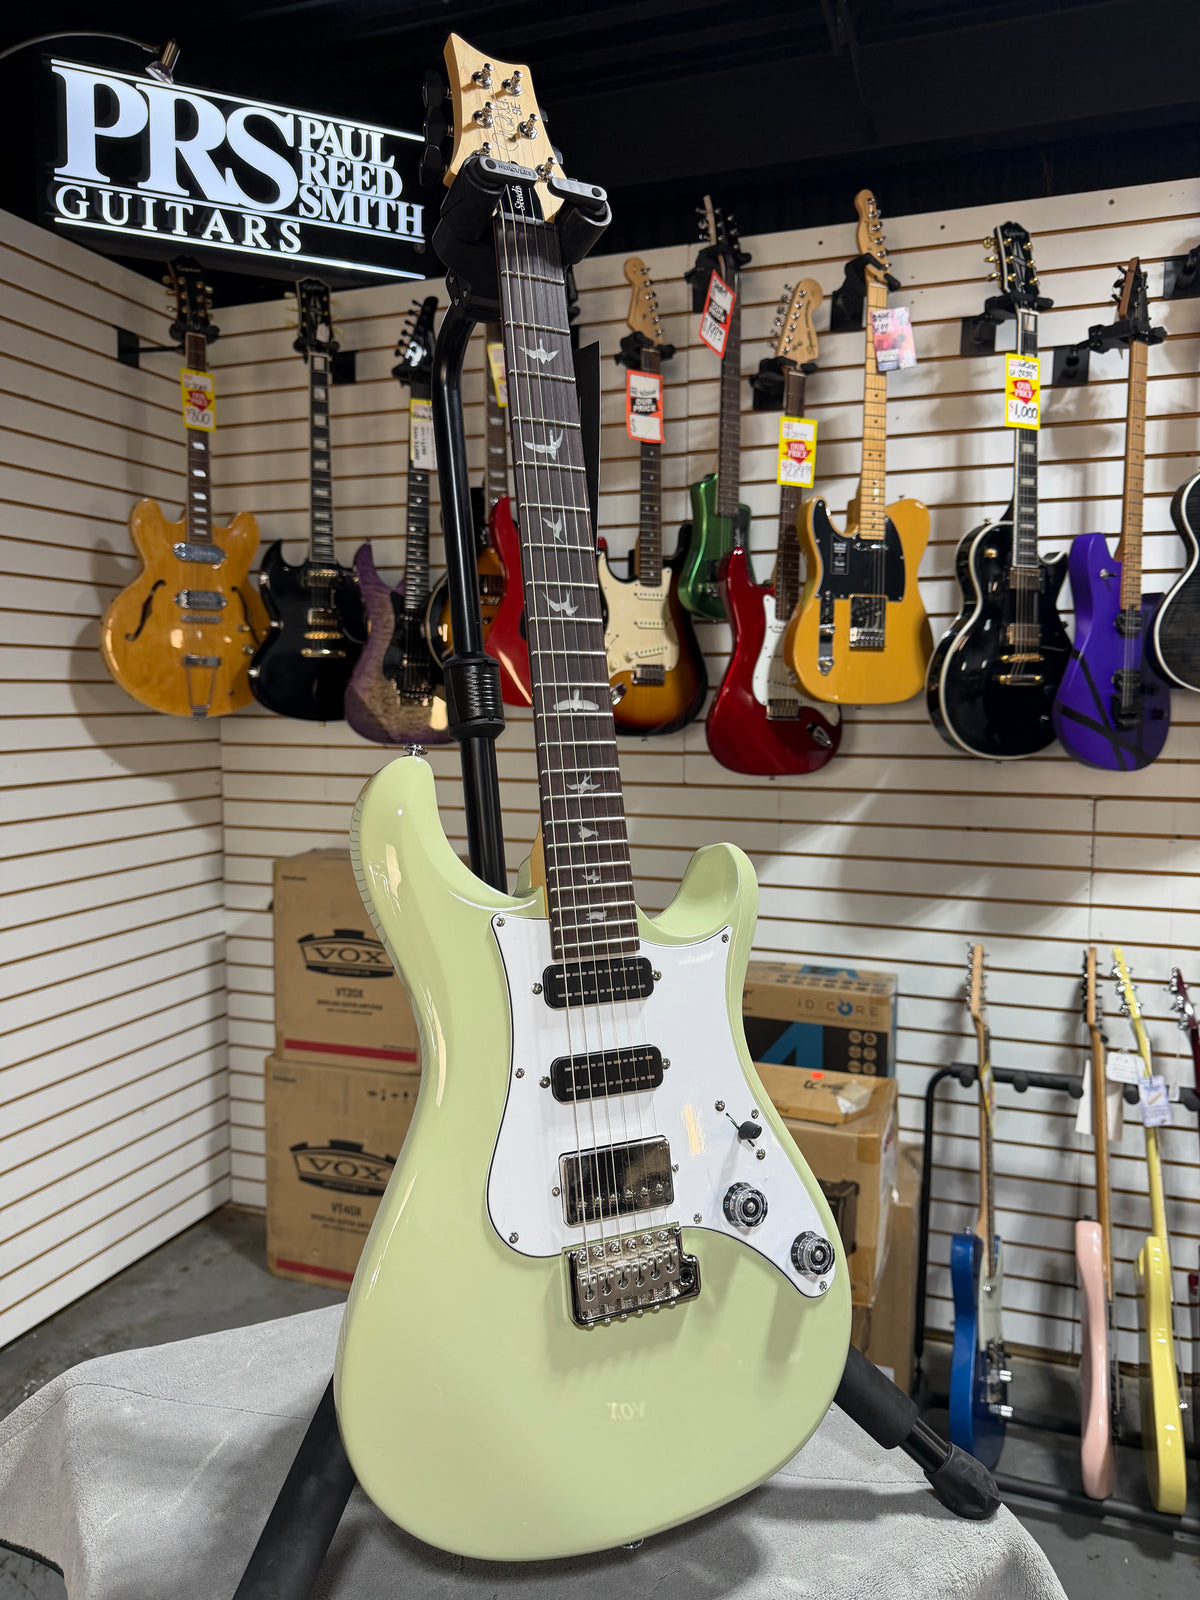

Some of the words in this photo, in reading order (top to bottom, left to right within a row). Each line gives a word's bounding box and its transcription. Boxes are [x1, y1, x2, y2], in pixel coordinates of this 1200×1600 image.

[52, 66, 299, 212] PRS
[298, 117, 396, 168] PAUL
[299, 150, 403, 200] REED
[55, 185, 301, 254] GUITARS
[298, 184, 425, 238] SMITH
[632, 404, 658, 413] PRICE
[634, 398, 653, 406] OUR
[312, 947, 387, 965] VOX
[309, 1156, 388, 1182] VOX
